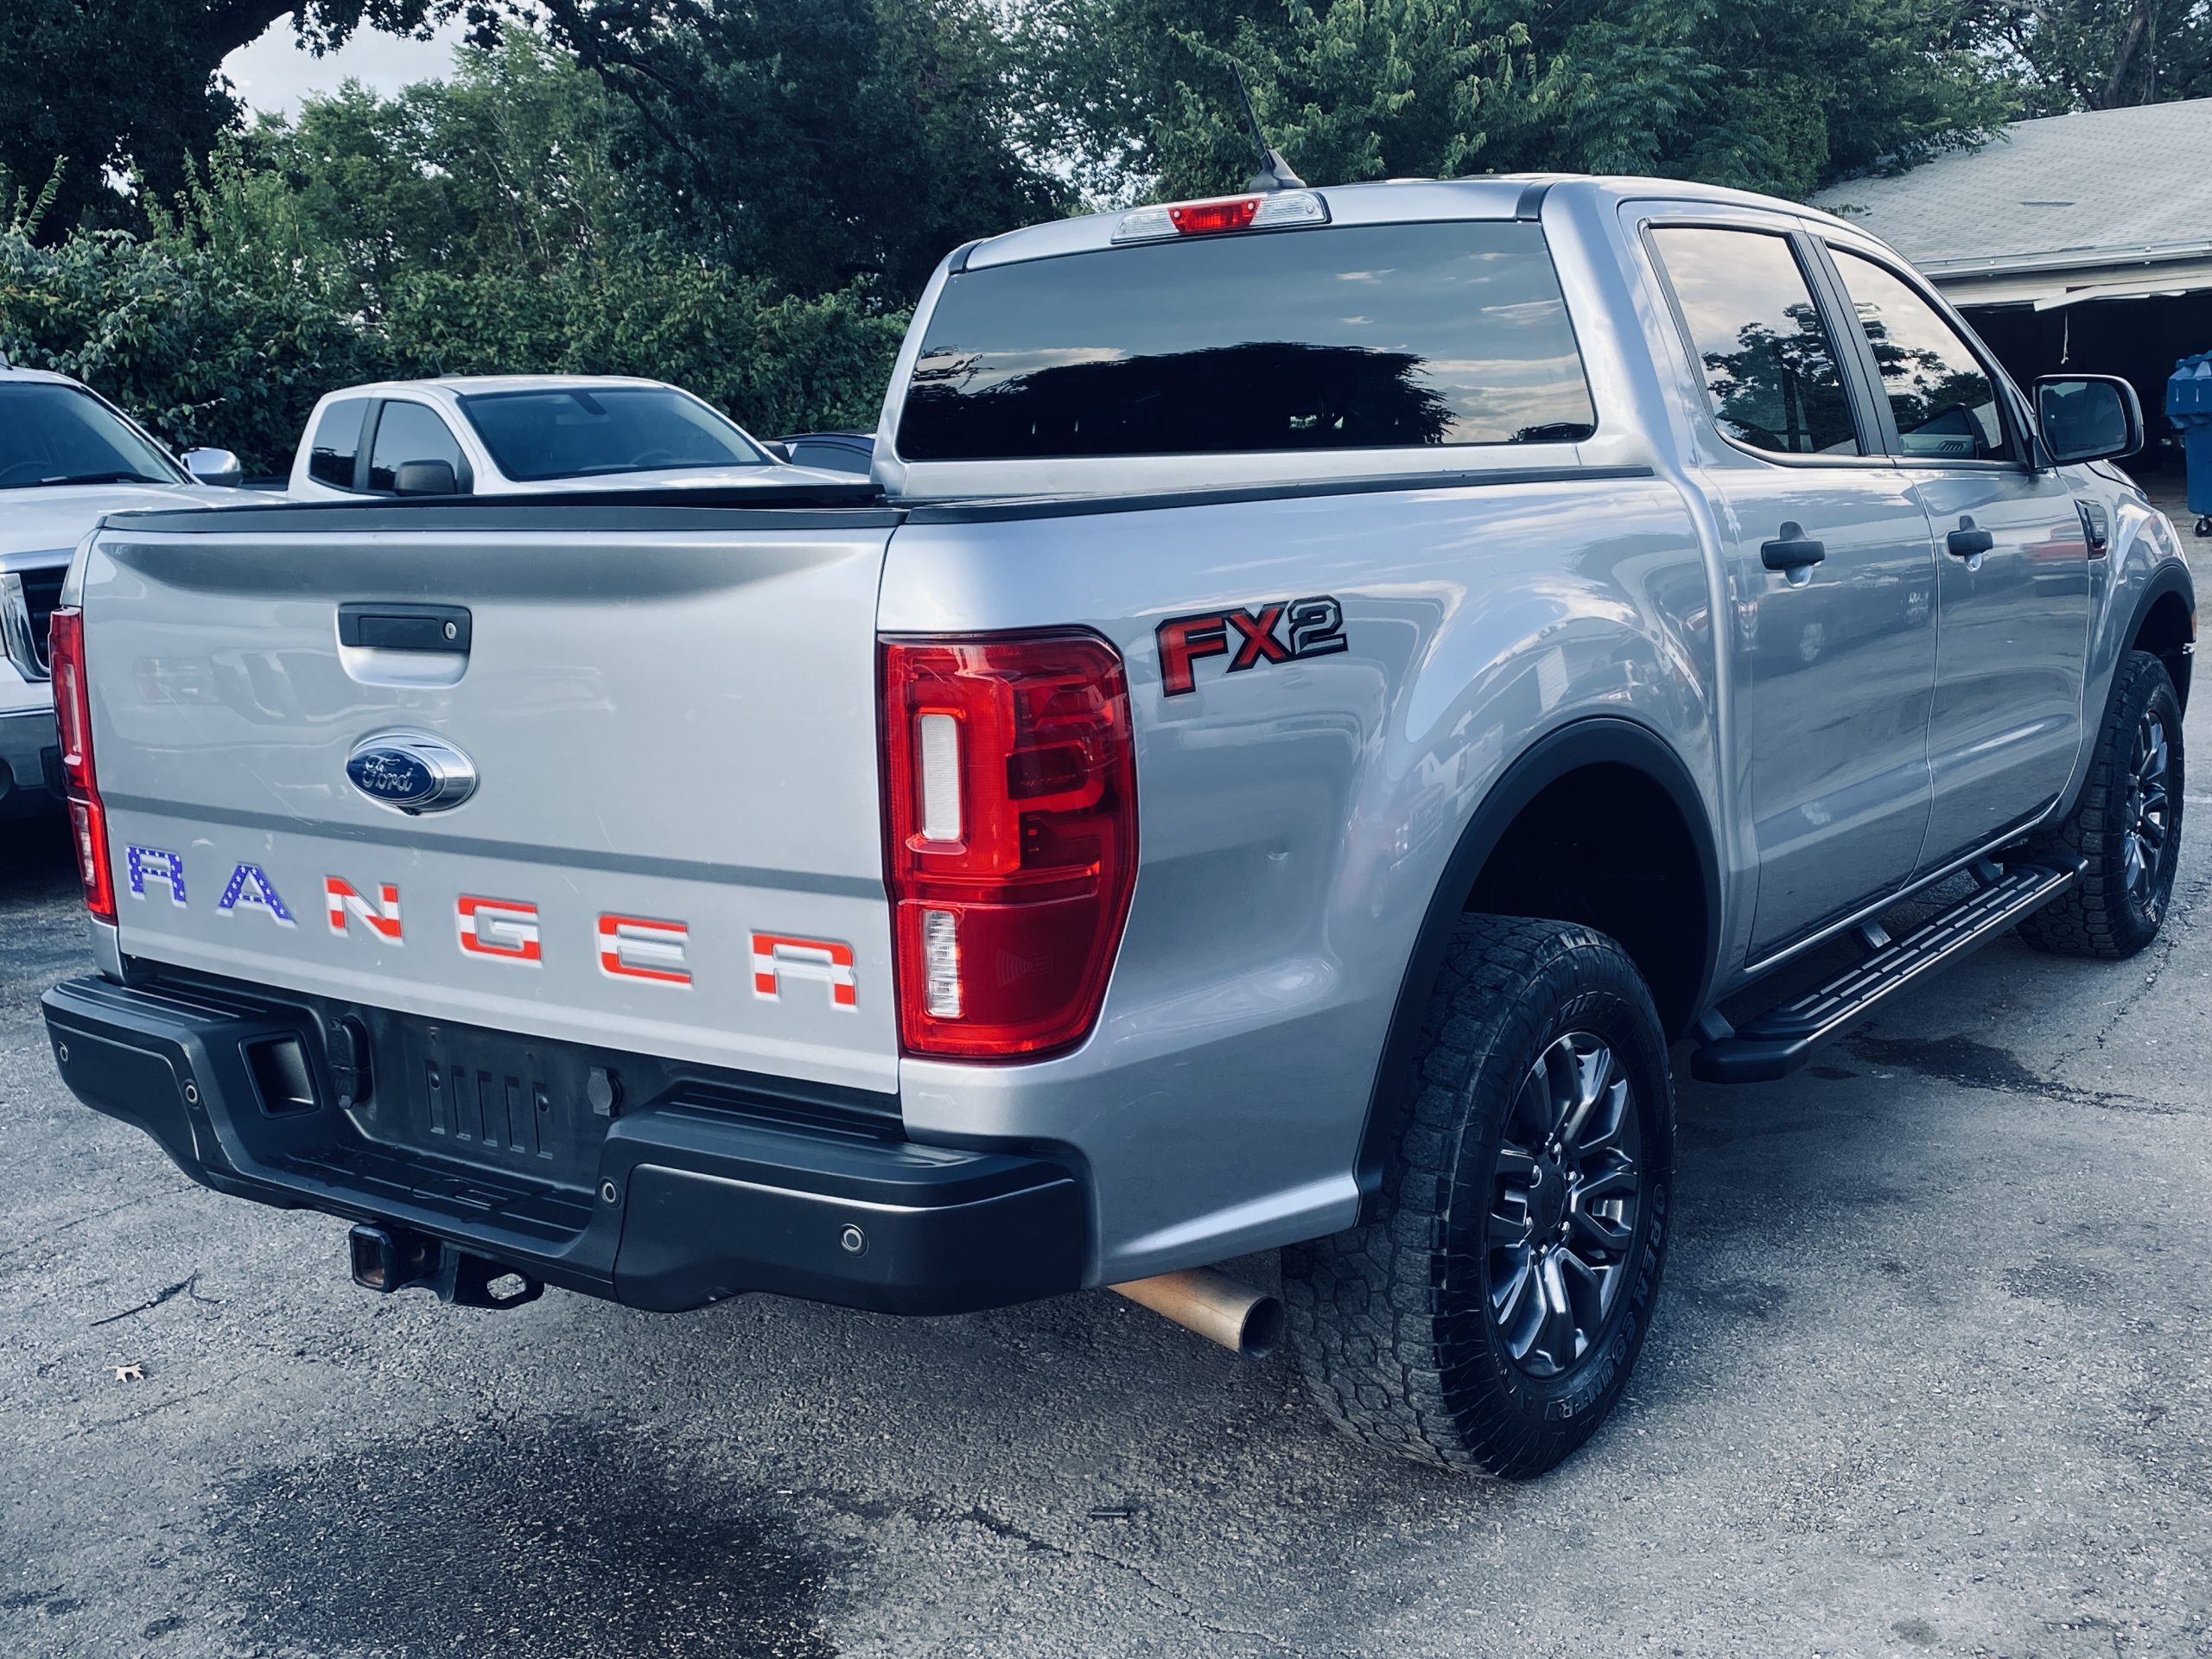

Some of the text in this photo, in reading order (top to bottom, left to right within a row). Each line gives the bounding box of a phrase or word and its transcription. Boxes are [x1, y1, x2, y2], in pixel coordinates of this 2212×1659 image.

[1154, 594, 1348, 697] FX2
[361, 754, 415, 792] Ford
[127, 844, 859, 1009] RANGER
[1634, 1184, 1666, 1306] OPEN
